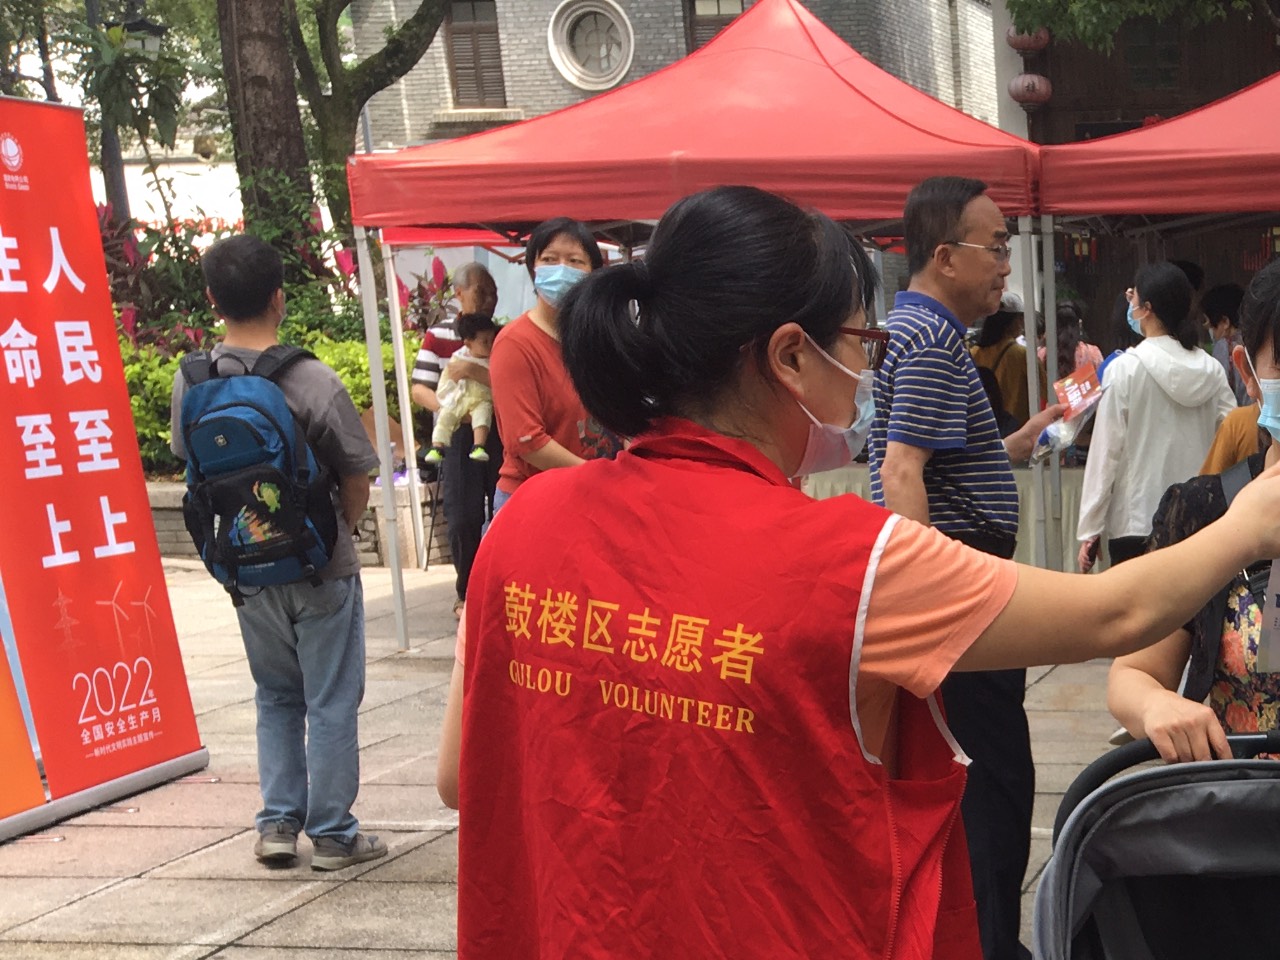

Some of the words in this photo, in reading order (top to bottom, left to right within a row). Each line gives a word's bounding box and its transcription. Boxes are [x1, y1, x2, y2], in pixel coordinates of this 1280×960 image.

[42, 227, 136, 559] 人民至上
[504, 581, 764, 684] 鼓楼区志愿者
[72, 656, 157, 725] 2022
[80, 706, 162, 746] 全国安全生产月
[508, 659, 572, 696] GULOU
[599, 679, 755, 733] VOLUNTEER
